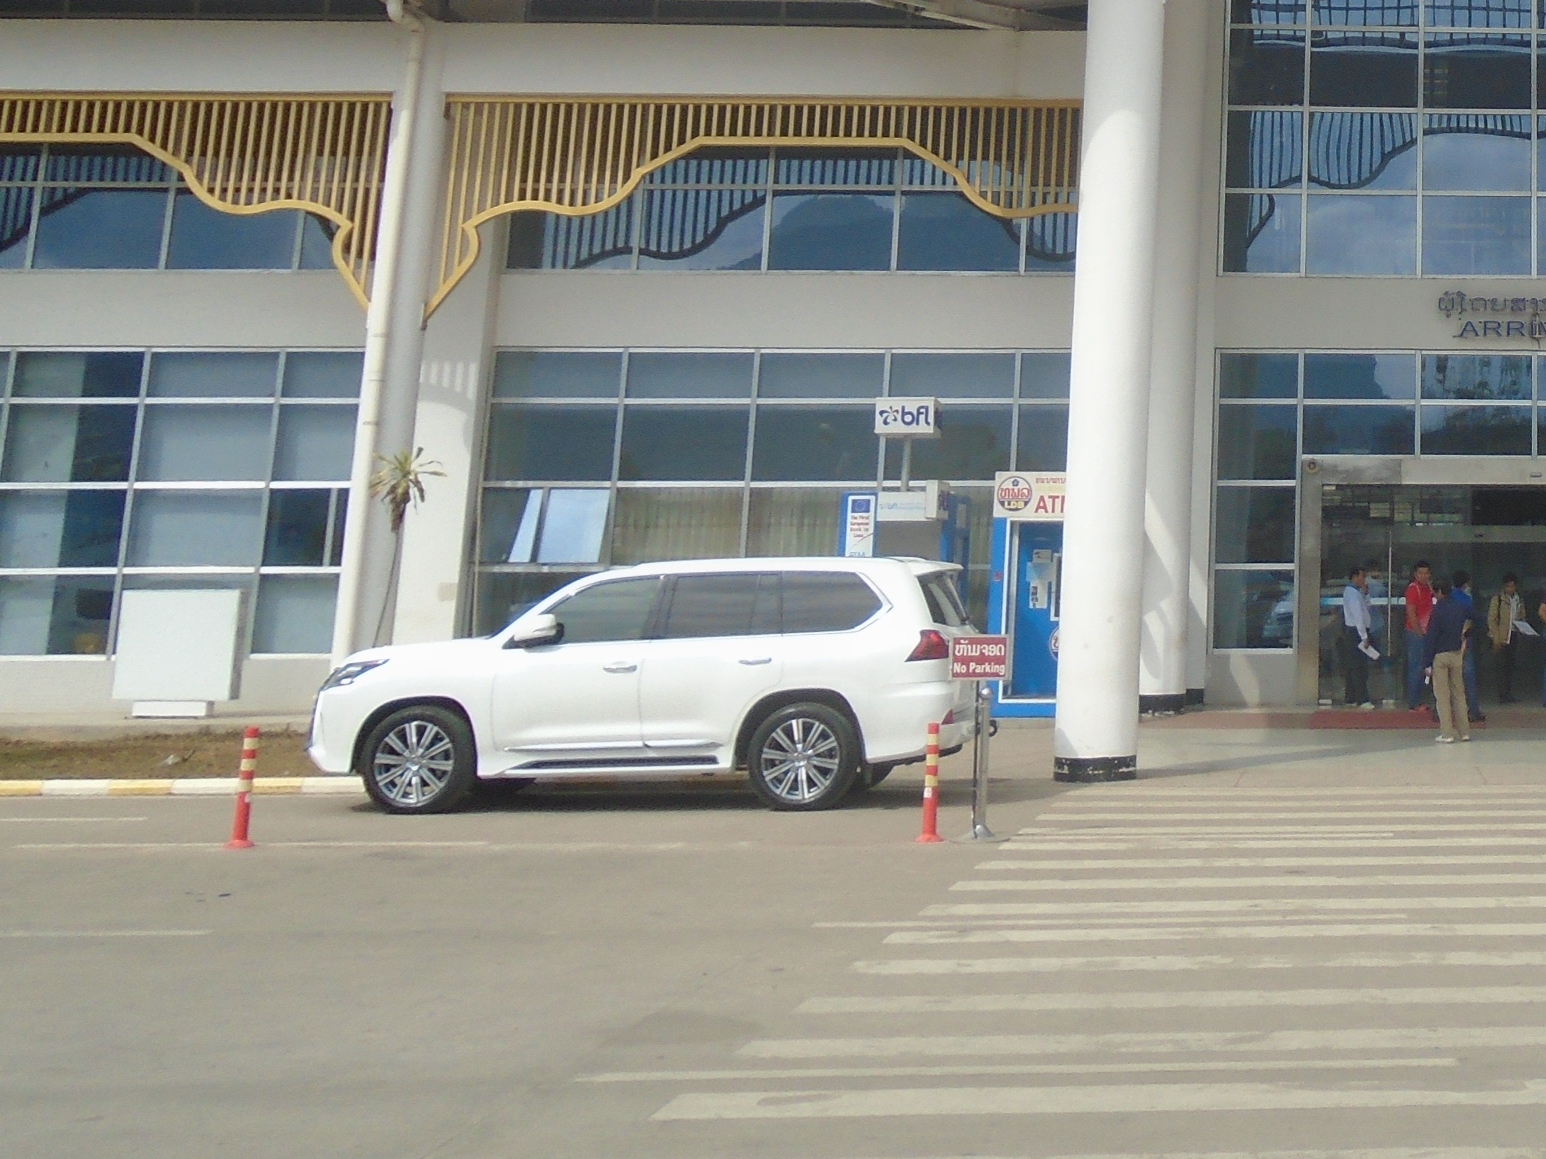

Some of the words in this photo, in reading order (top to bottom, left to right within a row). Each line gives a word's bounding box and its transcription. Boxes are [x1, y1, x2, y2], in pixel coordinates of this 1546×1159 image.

[901, 405, 930, 426] bfl
[953, 662, 967, 673] No
[969, 662, 1005, 676] Parking
